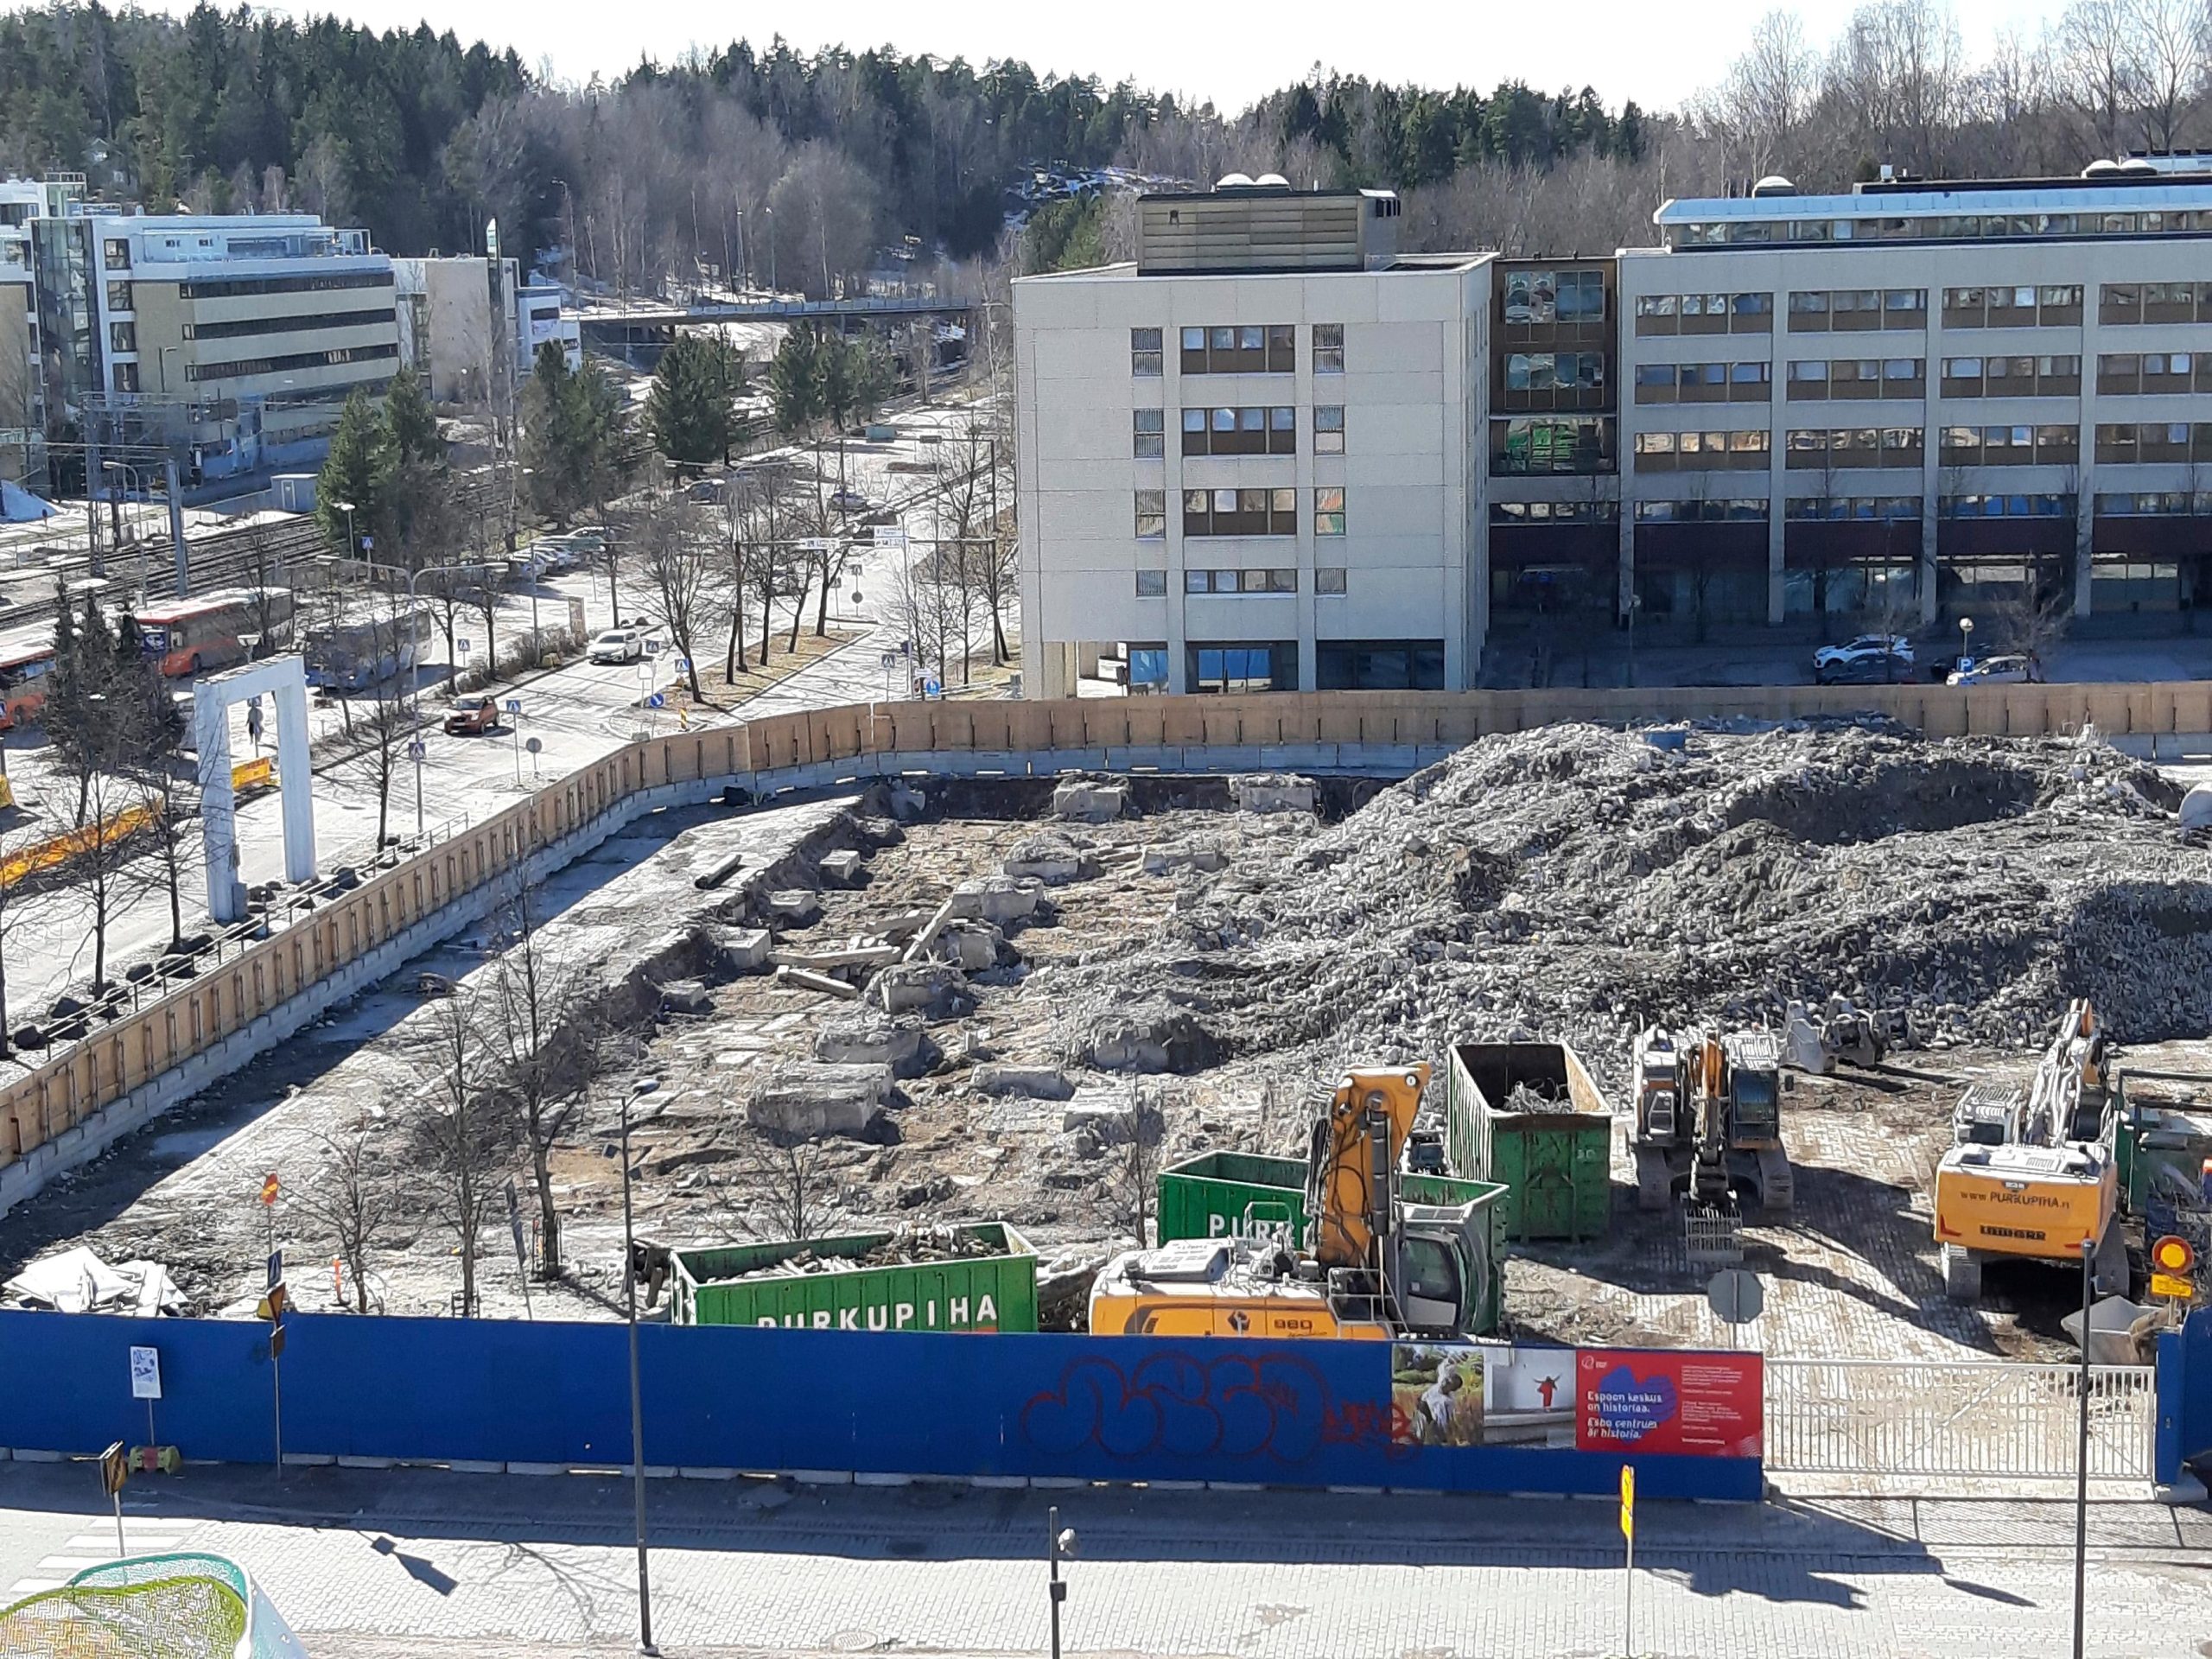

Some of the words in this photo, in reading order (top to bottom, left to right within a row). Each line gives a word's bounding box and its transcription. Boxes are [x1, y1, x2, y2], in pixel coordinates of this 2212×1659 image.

[1961, 658, 1972, 671] P
[1587, 1390, 1624, 1402] Espoon
[1628, 1392, 1662, 1403] keskus
[1603, 1402, 1650, 1413] historiaa.
[1587, 1417, 1612, 1427] Esbo
[1615, 1418, 1657, 1428] centrum
[1587, 1427, 1599, 1438] är
[1600, 1427, 1642, 1439] historia.
